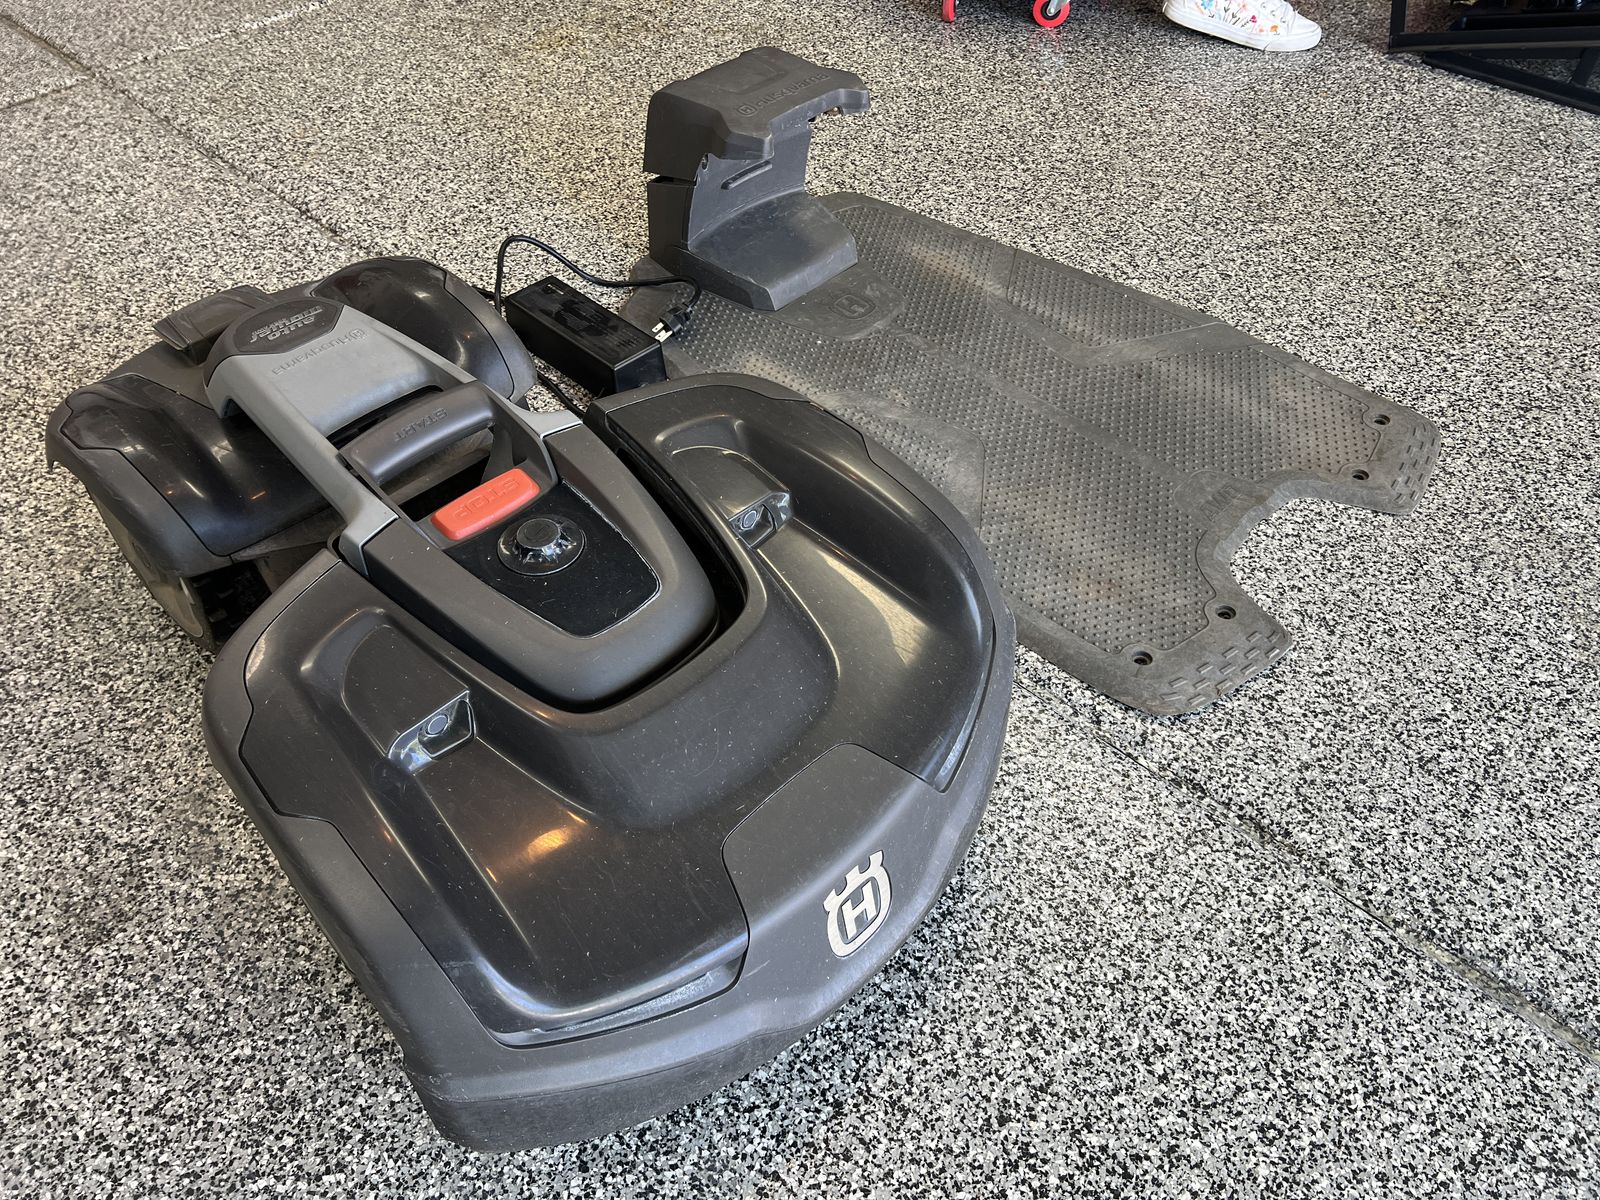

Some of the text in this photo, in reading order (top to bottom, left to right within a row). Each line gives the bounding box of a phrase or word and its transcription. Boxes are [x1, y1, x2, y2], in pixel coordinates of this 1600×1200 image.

[267, 316, 315, 341] auto
[394, 408, 447, 442] START
[454, 477, 519, 521] STOP
